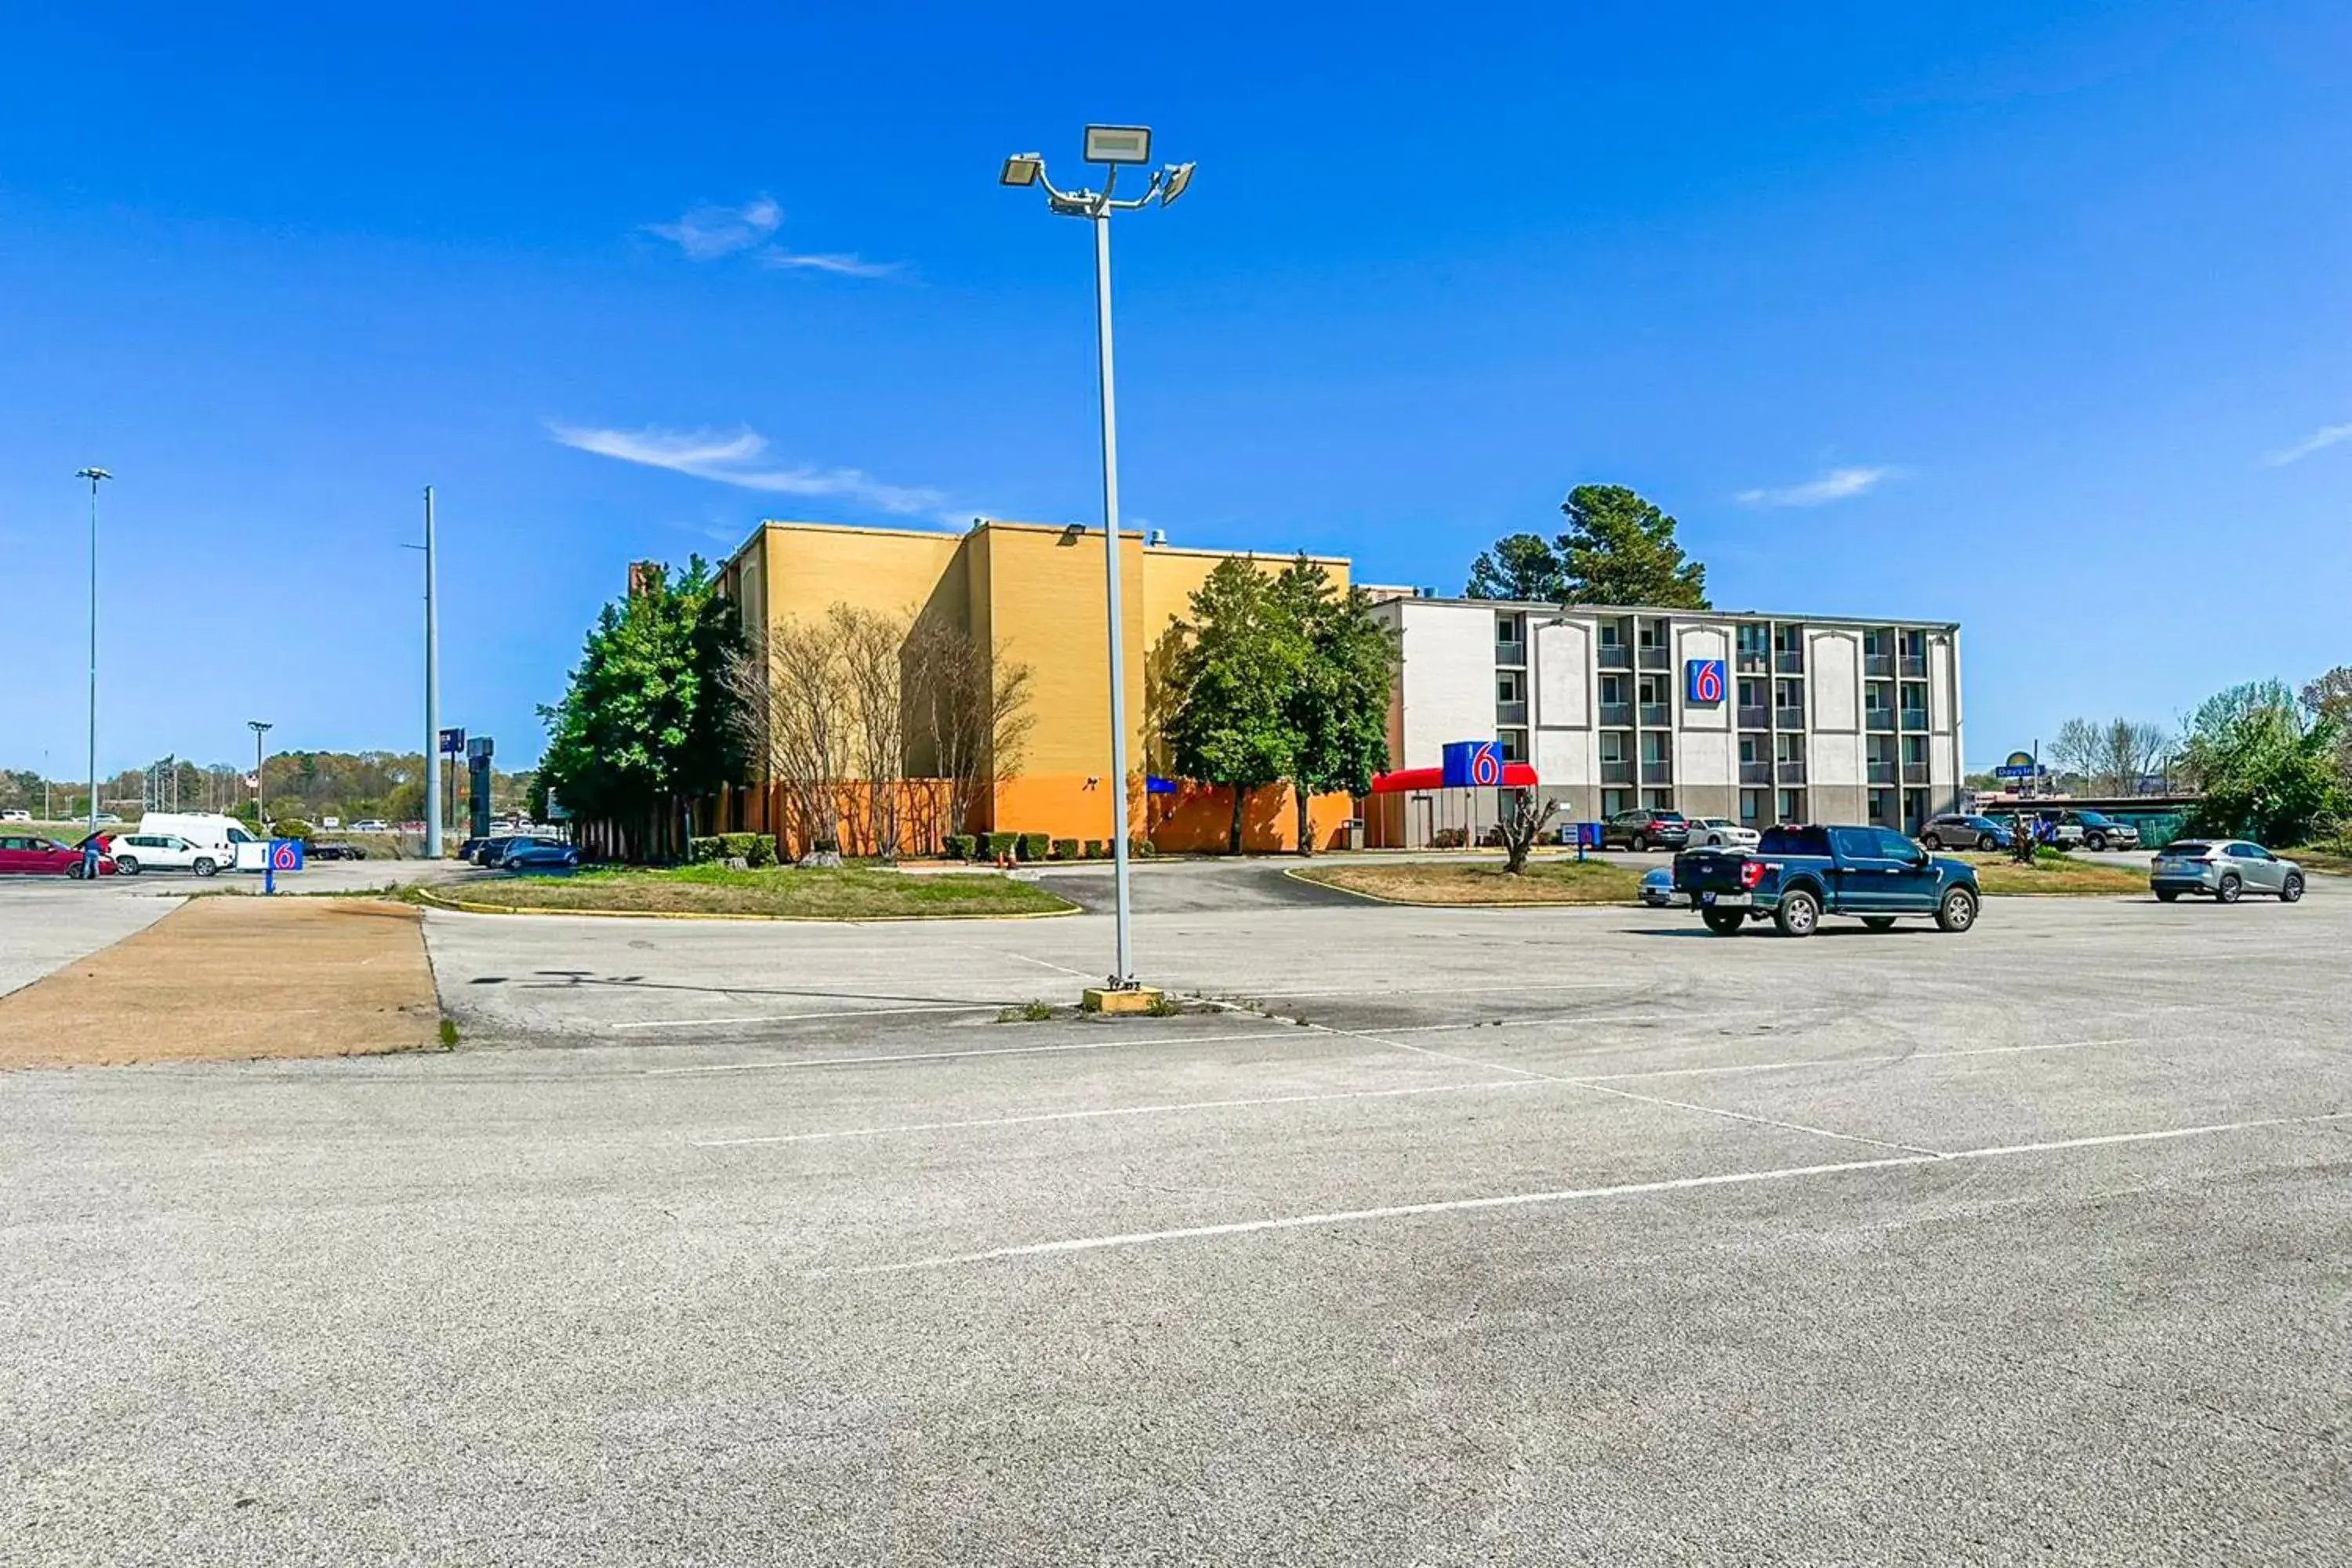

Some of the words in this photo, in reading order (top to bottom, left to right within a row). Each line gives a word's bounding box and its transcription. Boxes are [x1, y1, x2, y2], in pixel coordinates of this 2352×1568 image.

[1697, 661, 1721, 702] 6
[1472, 742, 1498, 786] 6
[274, 843, 296, 869] 6
